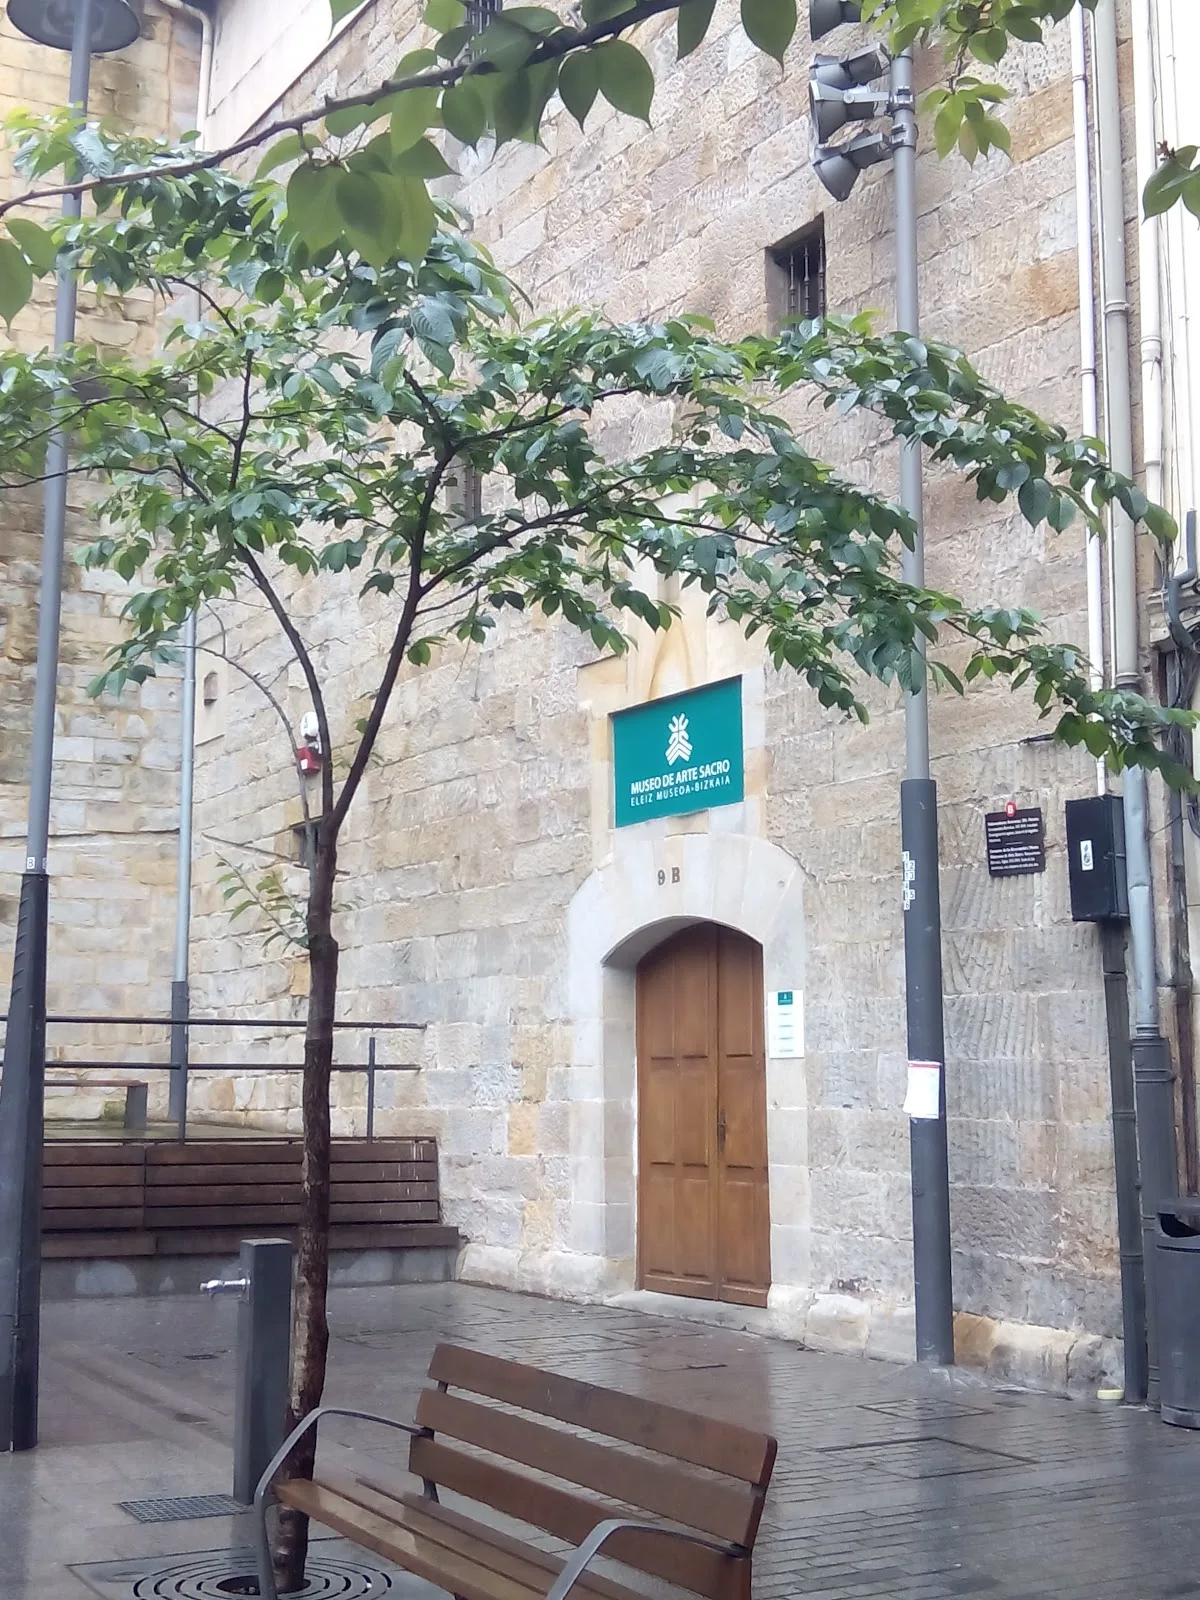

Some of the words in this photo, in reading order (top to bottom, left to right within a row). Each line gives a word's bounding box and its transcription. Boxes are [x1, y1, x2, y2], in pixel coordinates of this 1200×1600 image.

[631, 776, 661, 795] MUSEO
[662, 772, 675, 788] DE
[675, 766, 698, 785] ARTE
[699, 759, 730, 779] SACRO
[630, 793, 653, 807] ELEIZ
[657, 869, 666, 886] 9
[671, 866, 681, 884] B
